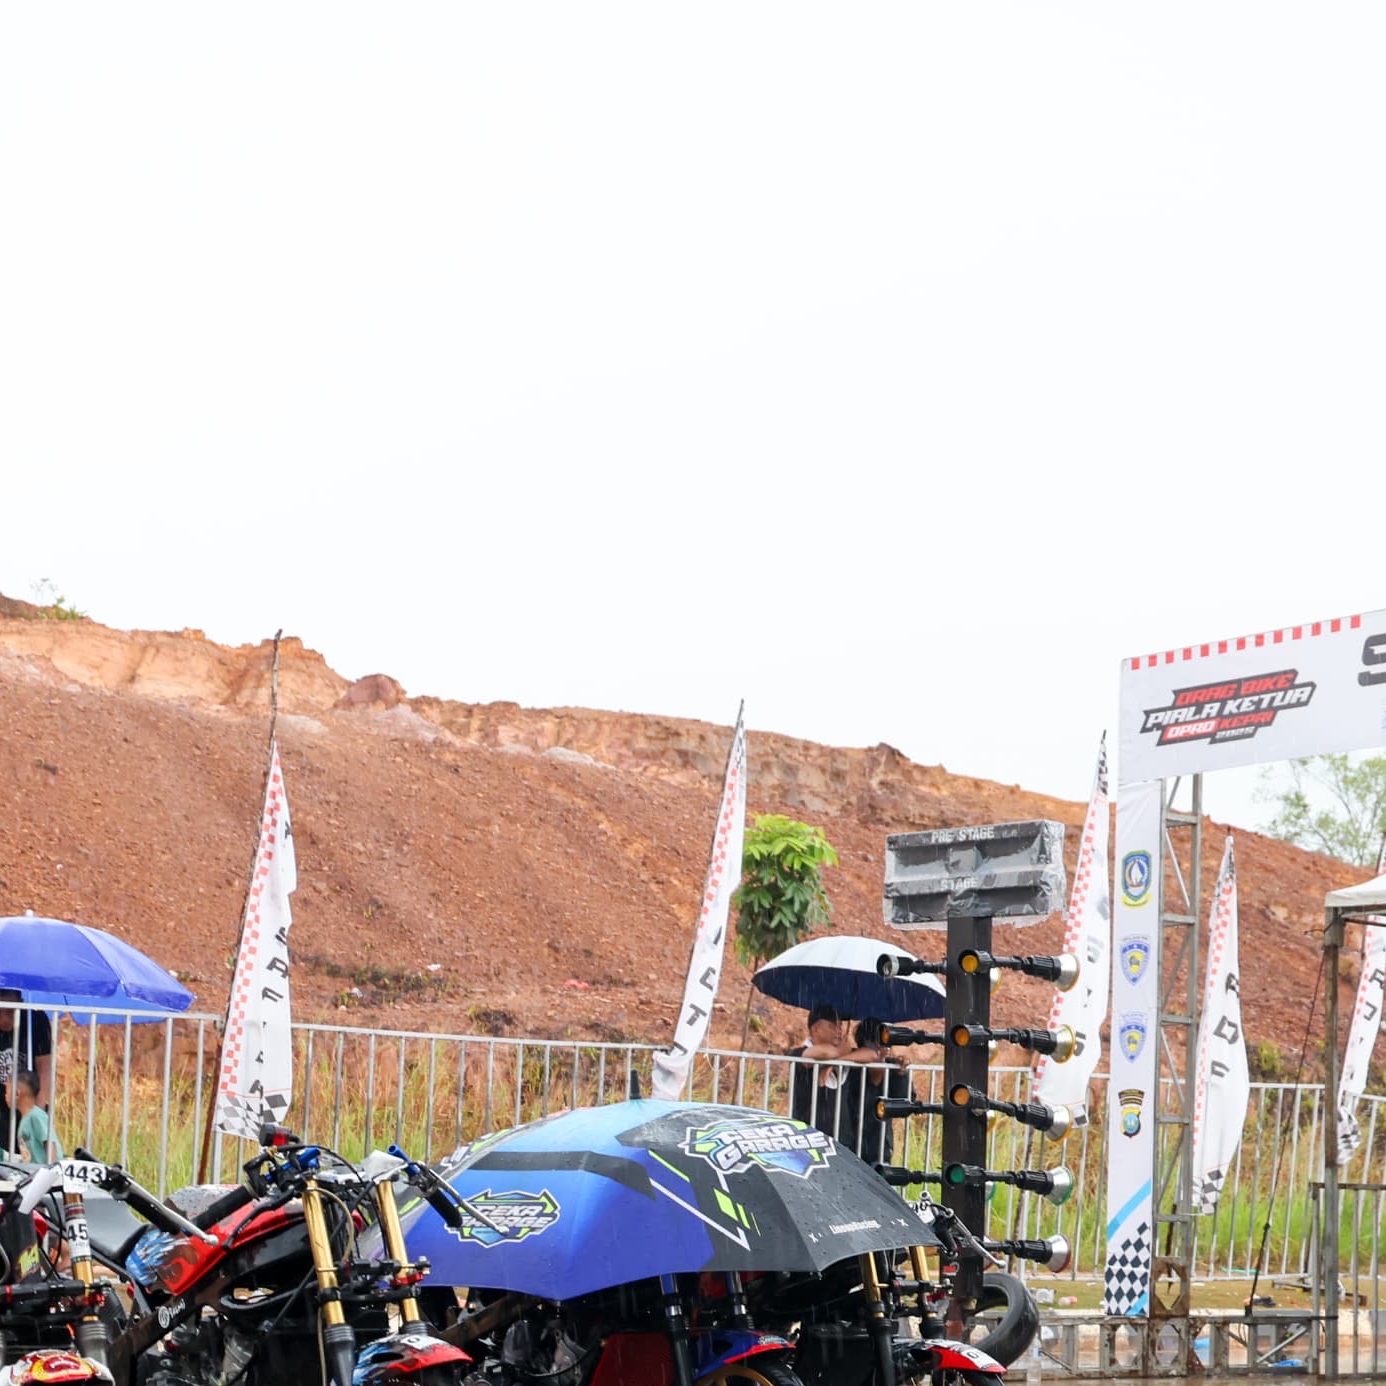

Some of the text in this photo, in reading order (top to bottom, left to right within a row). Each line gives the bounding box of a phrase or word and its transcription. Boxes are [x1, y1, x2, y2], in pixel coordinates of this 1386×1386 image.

[1174, 673, 1296, 706] DRAG BIKE
[1145, 686, 1314, 728] PIALA KETUA
[1167, 721, 1217, 739] DPRD
[931, 826, 995, 843] PRE STAGE
[940, 877, 978, 890] STAGE
[713, 1124, 795, 1144] CEKA
[716, 1131, 829, 1170] GARAGE
[475, 1205, 543, 1216] CEKA
[67, 1223, 89, 1241] 45
